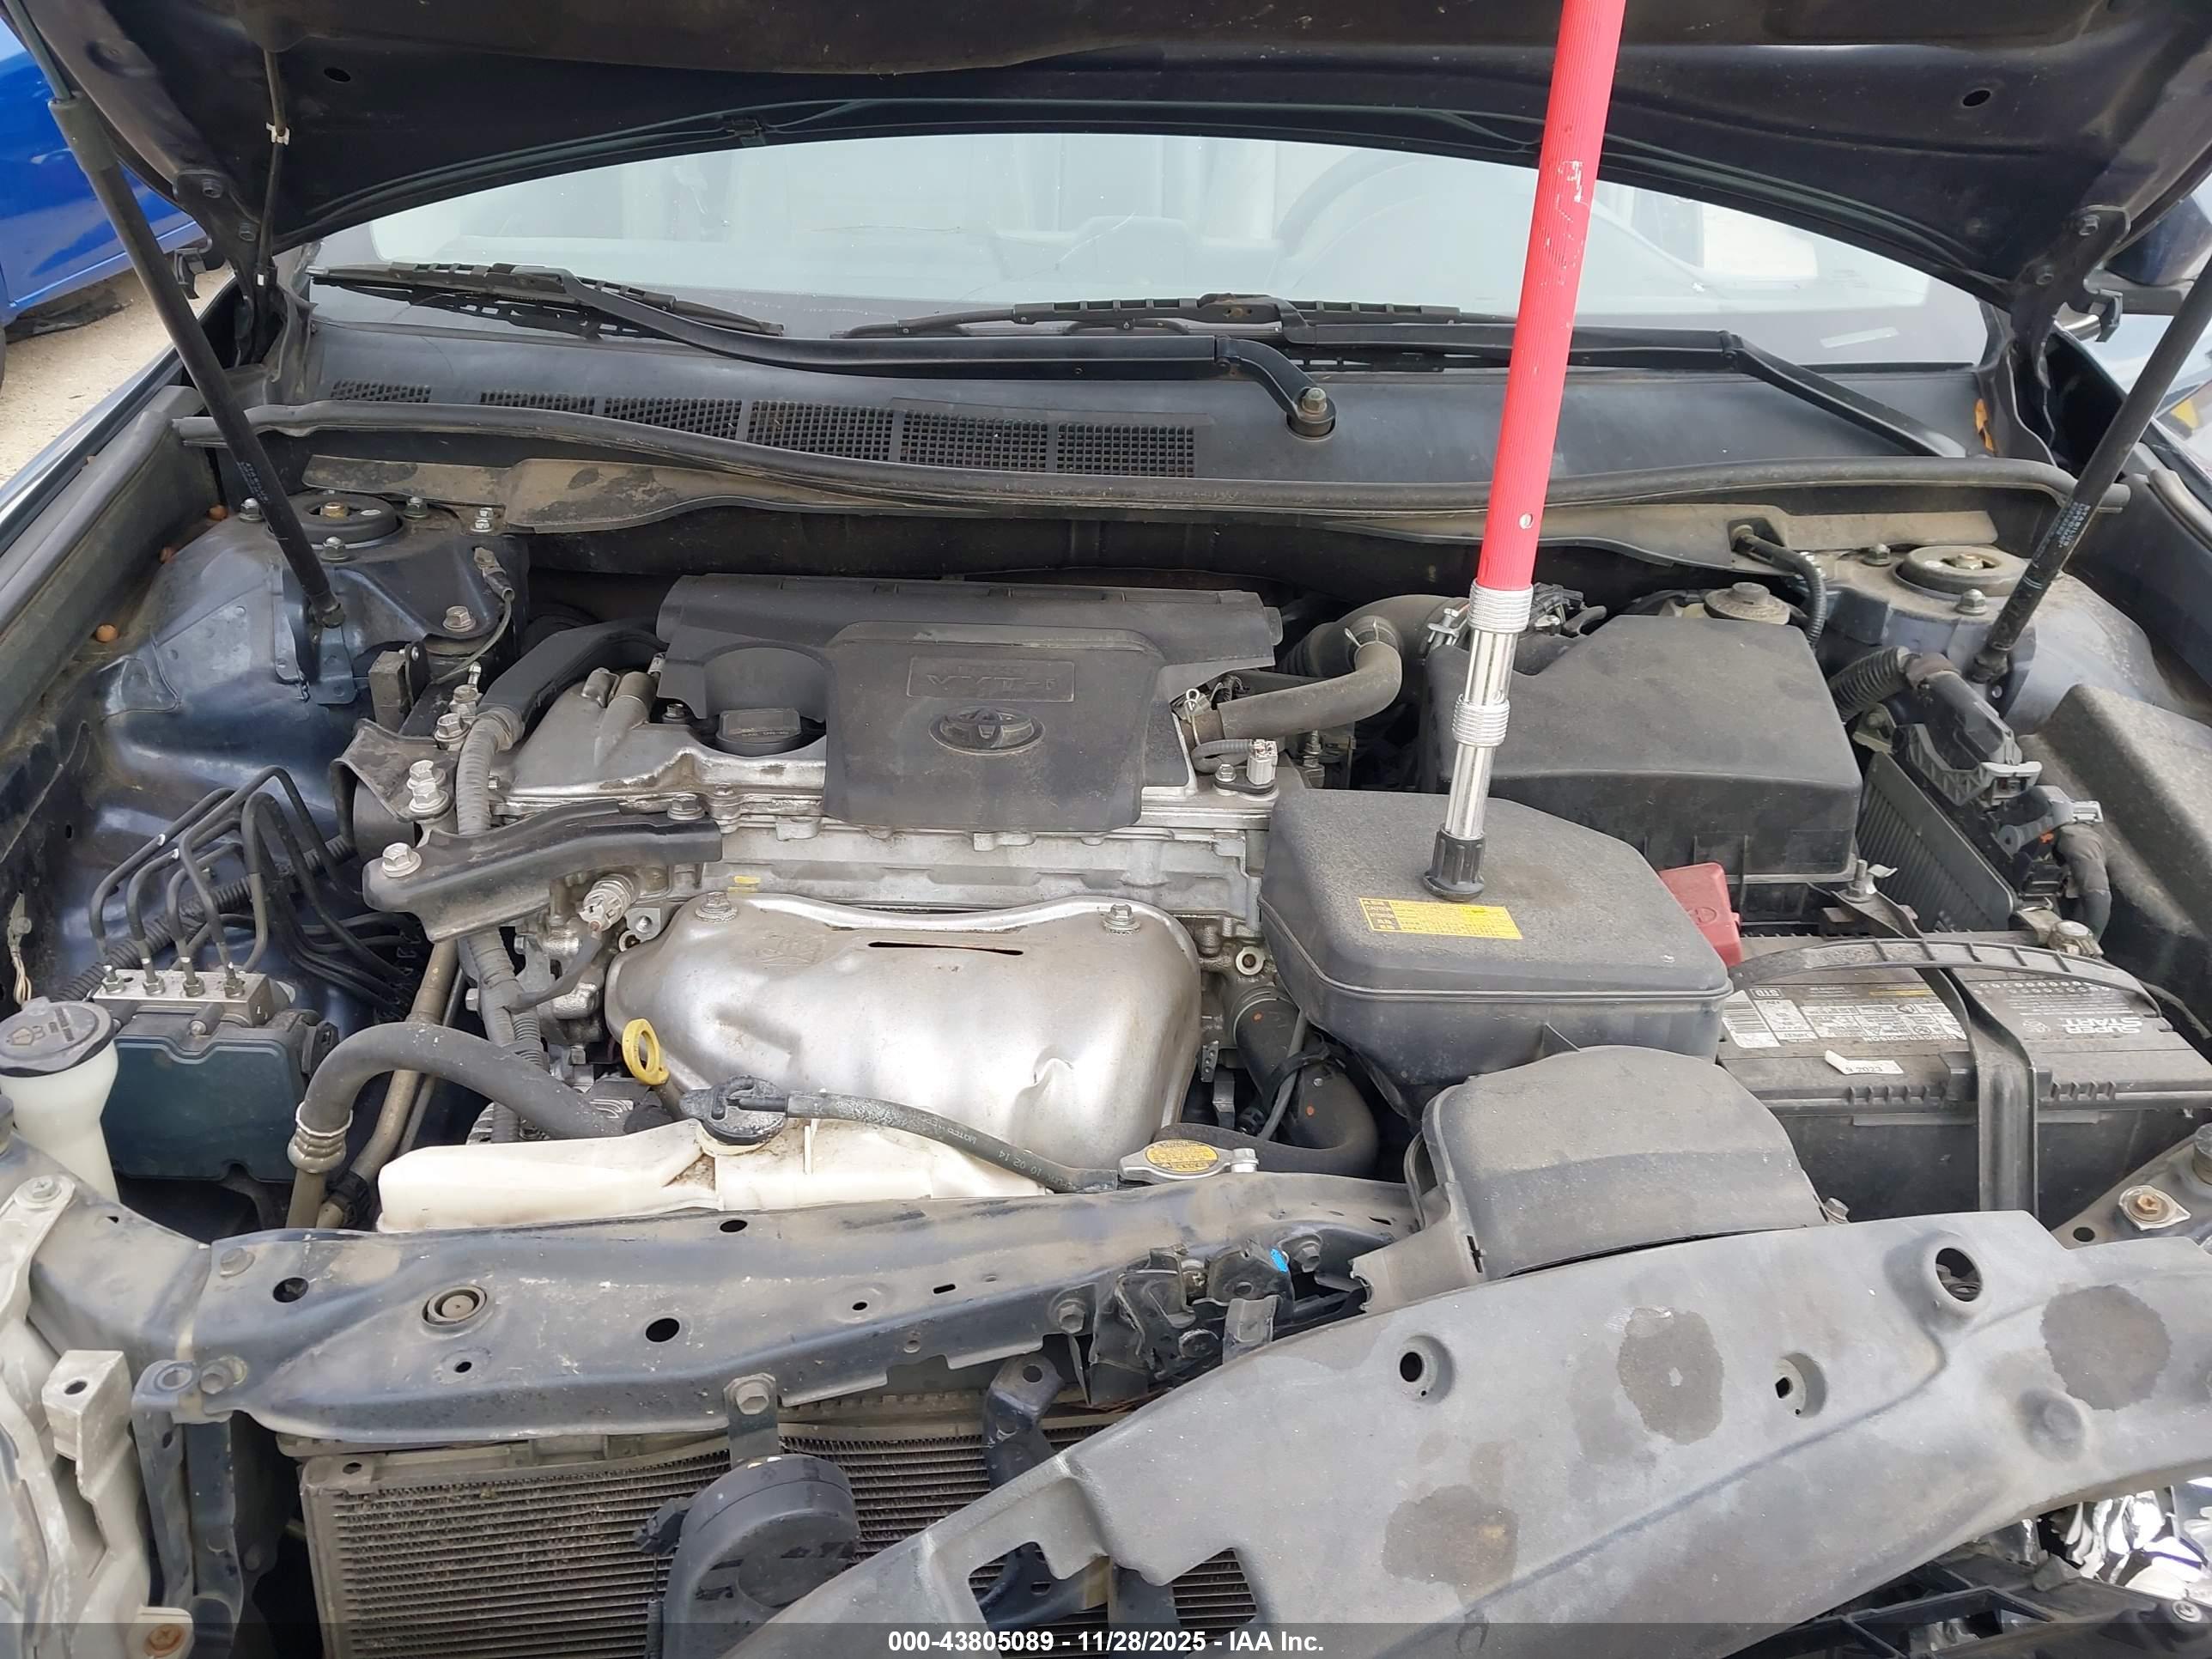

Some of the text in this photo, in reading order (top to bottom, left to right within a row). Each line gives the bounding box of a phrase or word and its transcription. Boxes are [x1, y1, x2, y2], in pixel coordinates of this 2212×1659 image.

[2062, 1017, 2143, 1027] START
[2064, 1025, 2142, 1034] SUPER
[998, 1150, 1011, 1163] 14
[1012, 1156, 1026, 1170] 02
[1030, 1165, 1042, 1177] 10
